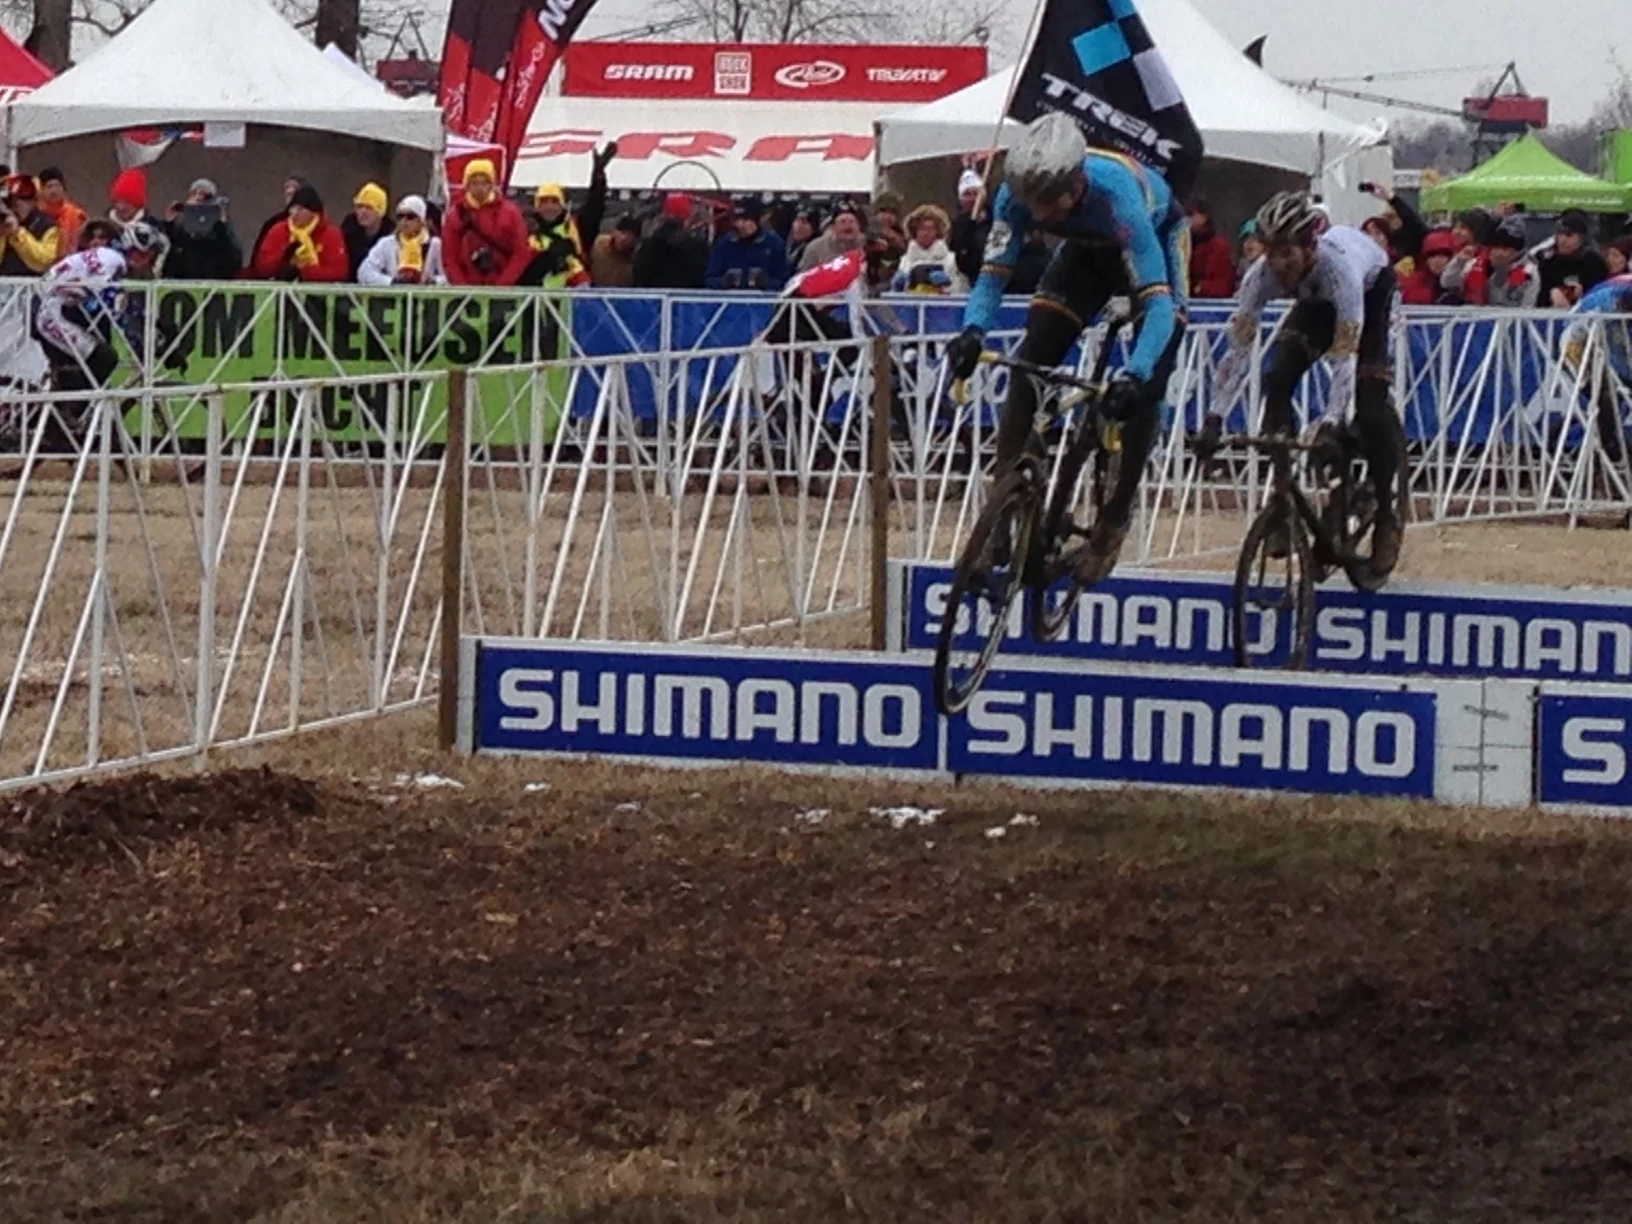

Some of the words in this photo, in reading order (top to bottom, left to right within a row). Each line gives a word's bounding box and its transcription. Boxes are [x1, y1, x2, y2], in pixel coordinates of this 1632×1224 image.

[1041, 73, 1183, 161] TREK
[1315, 607, 1632, 678] SHIMAN
[498, 667, 922, 749] SHIMANO
[966, 689, 1417, 778] SHIMANO
